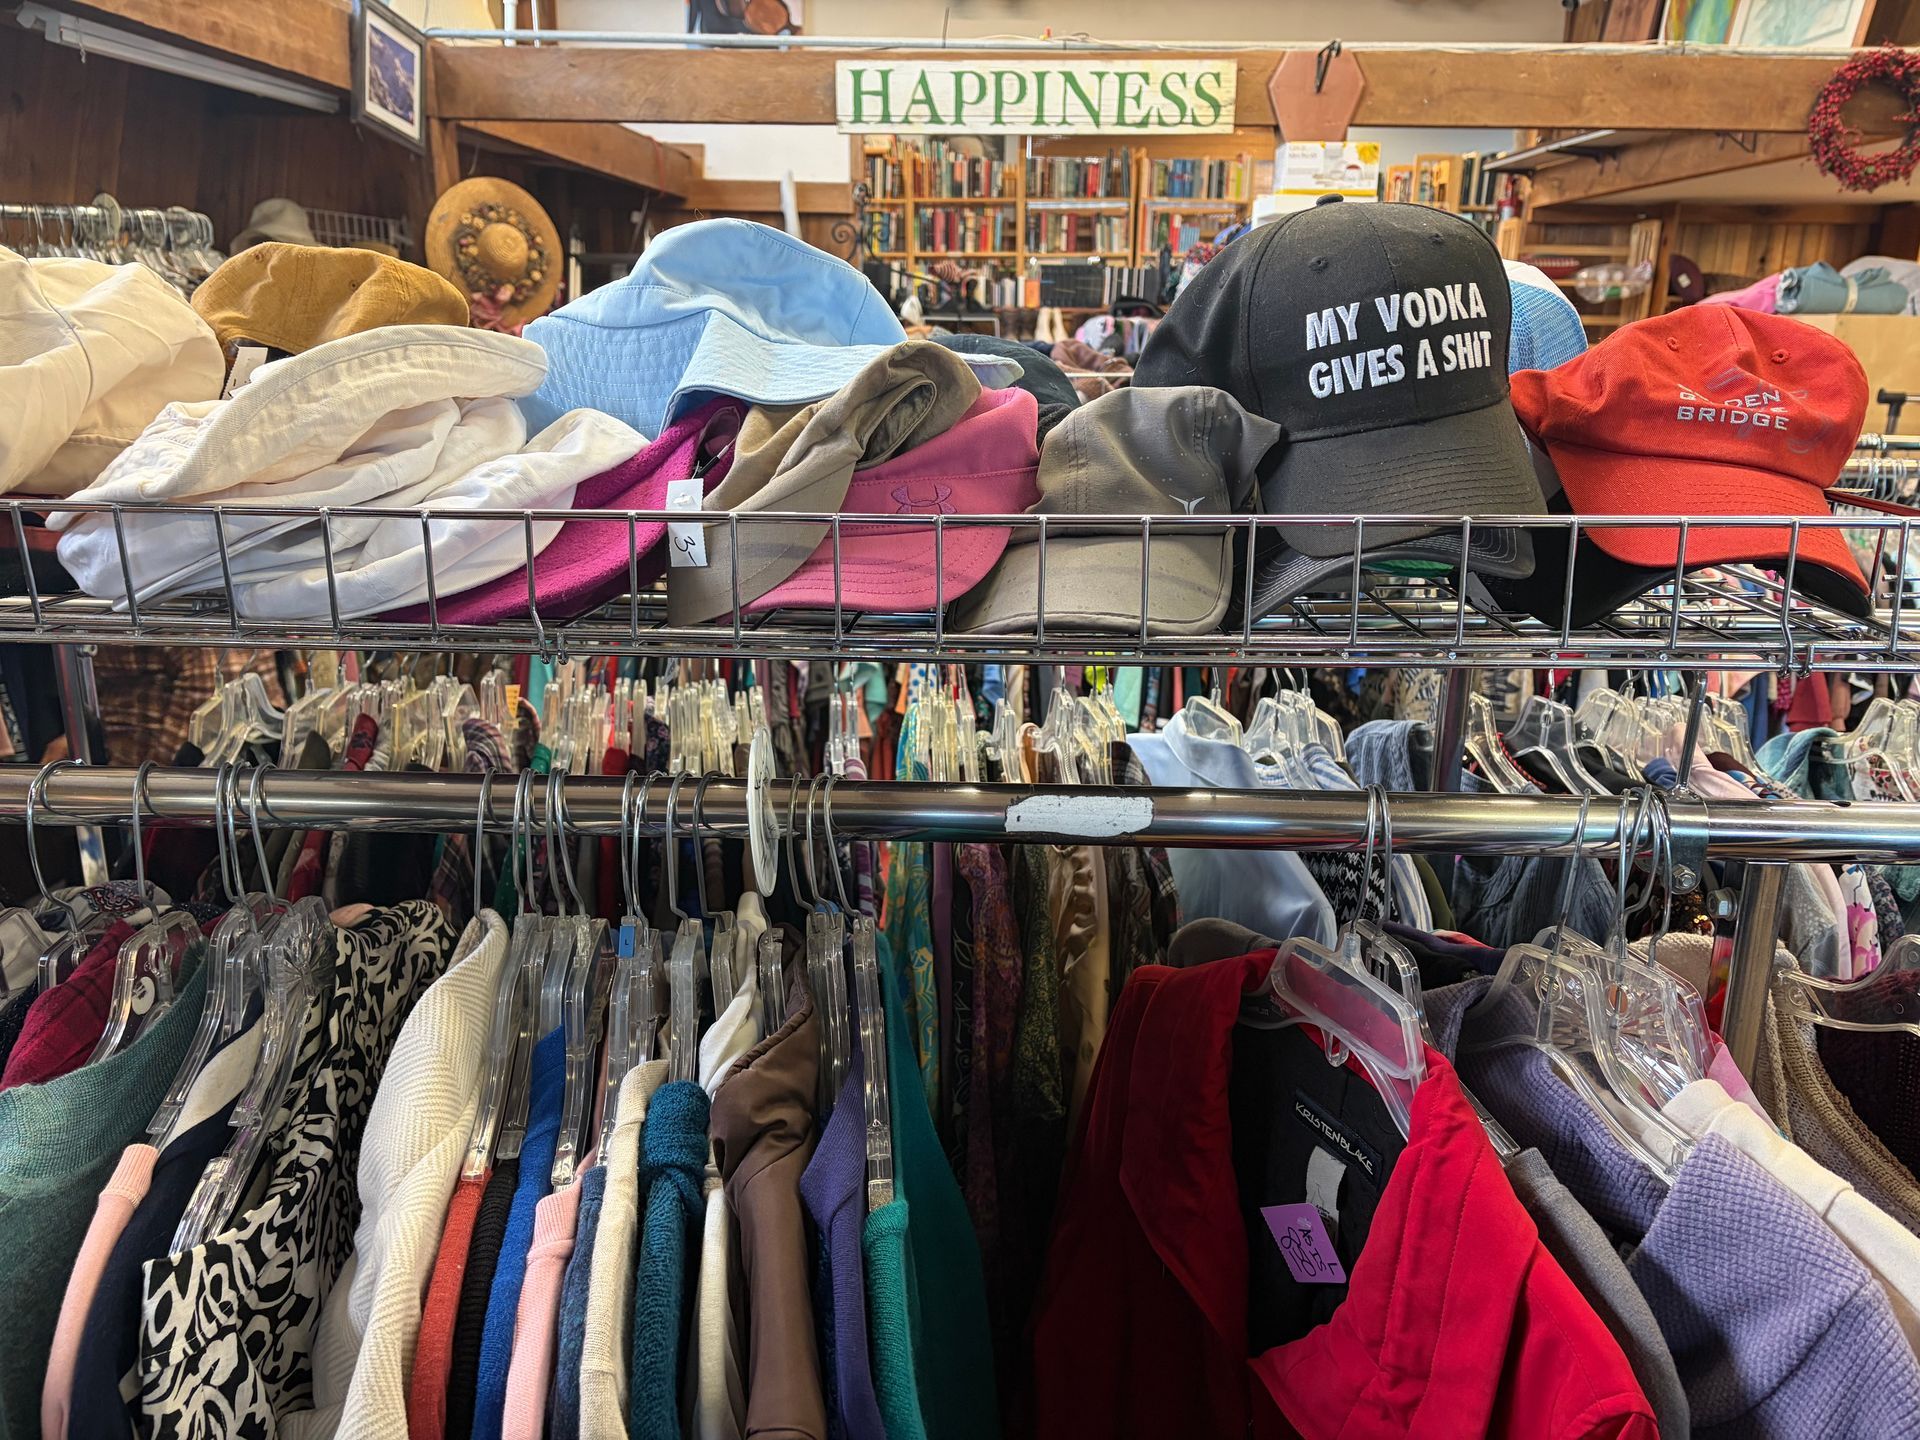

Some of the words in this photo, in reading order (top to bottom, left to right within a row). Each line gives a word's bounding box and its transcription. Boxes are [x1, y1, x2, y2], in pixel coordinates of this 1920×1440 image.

[848, 68, 1223, 129] HAPPINESS
[1305, 302, 1361, 350] MY
[1374, 282, 1487, 333] VODKA
[1308, 344, 1406, 399] GIVES
[1416, 338, 1439, 379] A
[1441, 331, 1492, 373] SHIT
[1677, 406, 1789, 431] BRIDGE
[1298, 1228, 1314, 1247] AS
[1311, 1248, 1328, 1272] IS
